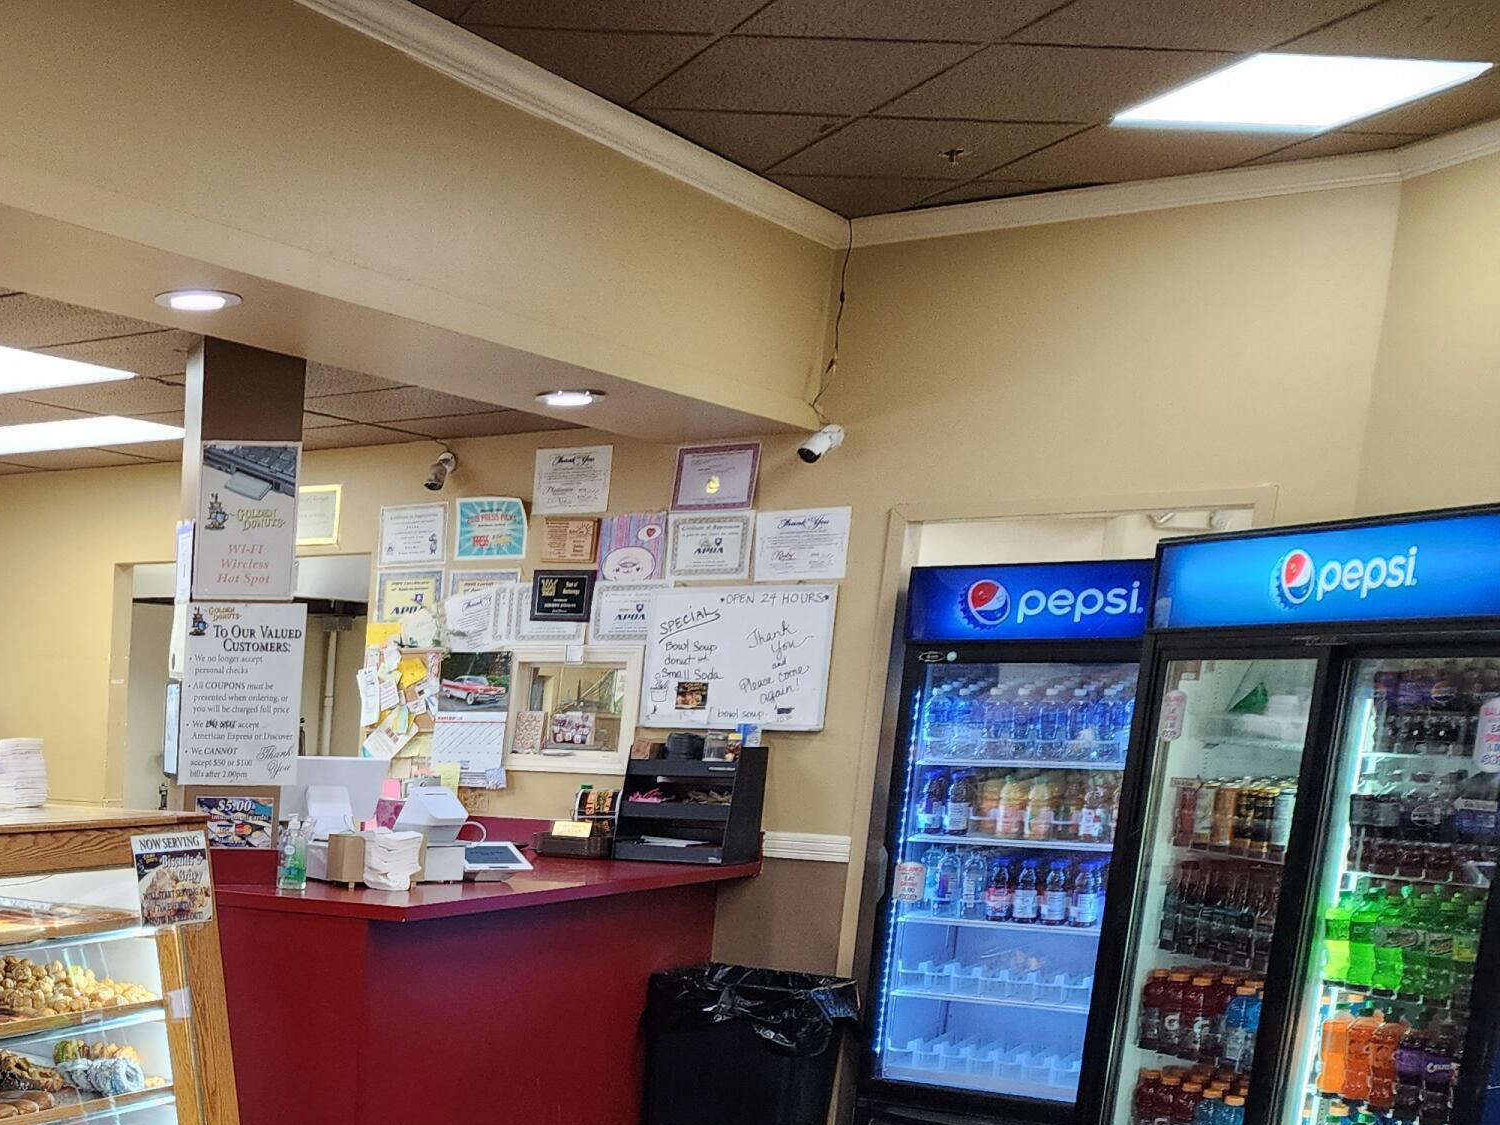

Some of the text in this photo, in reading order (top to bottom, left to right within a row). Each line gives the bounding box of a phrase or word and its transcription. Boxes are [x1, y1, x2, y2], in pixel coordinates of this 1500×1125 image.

[237, 508, 277, 521] GOLDEN
[228, 544, 263, 554] WI-FI
[220, 559, 269, 569] Wireless
[1316, 545, 1418, 598] pepsi
[217, 574, 270, 586] Hot Spot
[726, 592, 824, 605] OPEN 24 HOURS
[1017, 580, 1144, 623] pepsi
[659, 606, 719, 636] SPECIAL
[231, 625, 256, 639] OUR
[260, 625, 302, 639] VALUED
[747, 620, 798, 648] Thank
[223, 639, 291, 653] CUSTOMERS:
[665, 640, 718, 656] Bowl Soup
[194, 654, 205, 662] We
[218, 654, 239, 664] longer
[241, 655, 263, 665] accept
[664, 655, 695, 665] donut
[771, 657, 787, 670] and
[194, 666, 248, 675] personal checks
[662, 667, 725, 681] Small Soda
[193, 681, 204, 689] All
[247, 682, 264, 690] must
[265, 681, 274, 689] be
[738, 666, 810, 694] Please come
[759, 678, 801, 705] again!
[193, 694, 226, 703] presented
[248, 694, 278, 703] ordering,
[207, 705, 219, 713] will
[221, 705, 229, 713] be
[231, 705, 258, 715] charged
[260, 705, 271, 713] full
[273, 706, 290, 715] price
[717, 708, 739, 718] bowl
[193, 720, 260, 729] We accept
[191, 732, 225, 740] American
[227, 732, 253, 742] Express
[263, 732, 293, 740] Discover
[191, 747, 238, 755] We CANNOT
[256, 745, 295, 761] Thank
[190, 760, 212, 768] accept
[267, 761, 291, 779] You
[189, 769, 220, 778] bills after
[218, 800, 252, 811] $5.00
[138, 835, 200, 851] NOW SERVING
[162, 854, 194, 868] Biscuits
[178, 869, 203, 883] Gravy
